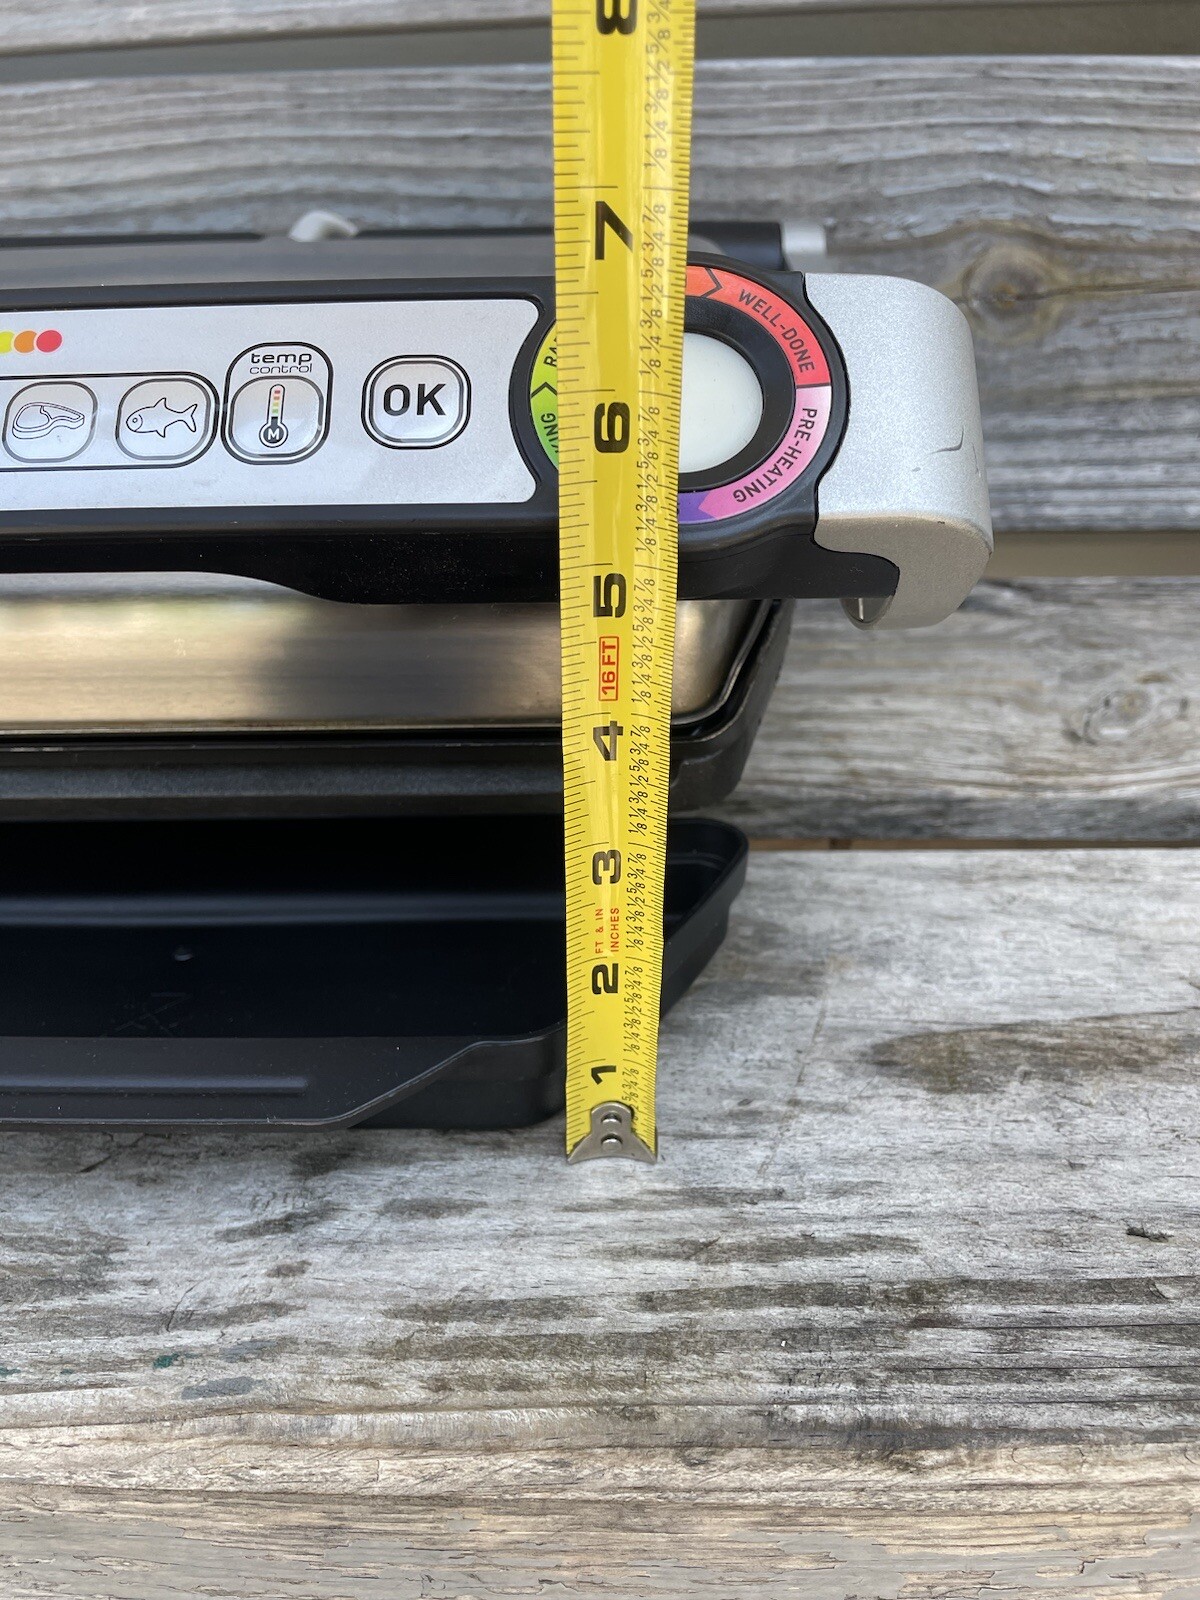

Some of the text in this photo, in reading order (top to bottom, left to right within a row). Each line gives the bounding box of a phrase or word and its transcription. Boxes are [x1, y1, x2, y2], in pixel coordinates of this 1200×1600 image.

[595, 201, 633, 260] 7
[737, 288, 815, 374] WELL-DONE
[249, 363, 313, 375] control
[250, 353, 313, 366] temp
[383, 383, 447, 417] OK
[267, 428, 280, 441] M
[593, 401, 630, 454] 6
[732, 407, 819, 503] PRE-HEATING
[593, 573, 627, 618] 5
[601, 641, 617, 695] 16 FT
[592, 720, 624, 762] 4
[592, 849, 621, 886] 3
[595, 908, 604, 920] IN
[610, 907, 620, 952] INCHES
[595, 941, 604, 954] FT
[591, 963, 619, 995] 2
[591, 1065, 617, 1085] 1
